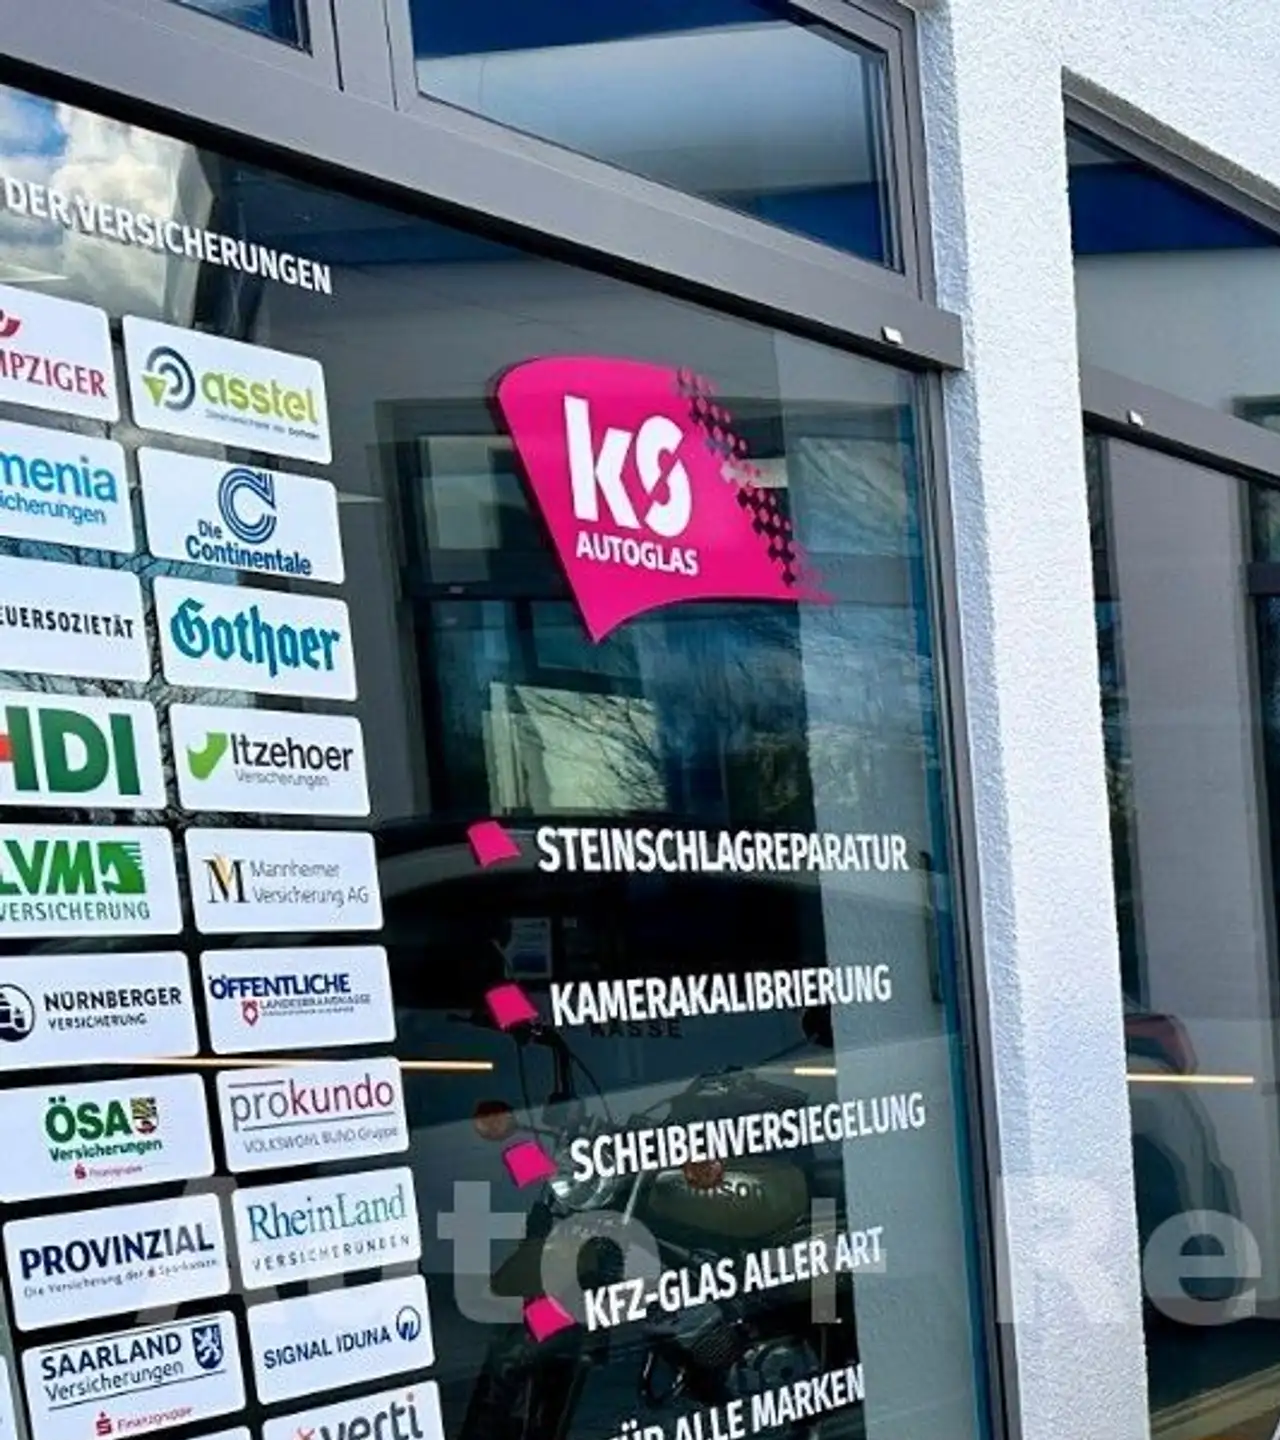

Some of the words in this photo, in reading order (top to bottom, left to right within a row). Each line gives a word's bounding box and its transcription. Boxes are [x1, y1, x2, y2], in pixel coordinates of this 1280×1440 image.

[5, 178, 72, 225] DER
[72, 194, 333, 294] VERSICHERUNGEN
[201, 371, 319, 424] asstel
[197, 519, 222, 539] Die
[185, 534, 312, 575] Continentale
[576, 531, 699, 576] AUTOGLAS
[170, 598, 341, 677] Gothaer
[230, 733, 353, 770] Itzehoer
[537, 826, 909, 872] STEINSCHLAGREPARATUR
[347, 886, 369, 903] AG
[43, 986, 182, 1012] NÜRNBERGER
[208, 973, 351, 1000] ÖFFENTLICHE
[550, 965, 892, 1027] KAMERAKALIBRIERUNG
[49, 1012, 147, 1031] VERSICHERUNG
[45, 1096, 132, 1143] ÖSA
[230, 1073, 395, 1132] prokundo
[49, 1139, 162, 1162] Versicherungen
[570, 1093, 926, 1181] SCHEIBENVERSIEGELUNG
[247, 1183, 407, 1243] RheinLand
[20, 1224, 214, 1280] PROVINZIAL
[583, 1258, 736, 1331] KFZ-GLAS
[743, 1239, 827, 1291] ALLER
[835, 1227, 883, 1271] ART
[41, 1333, 182, 1381] SAARLAND
[263, 1338, 332, 1369] SIGNAL
[336, 1326, 392, 1353] IDUNA
[45, 1361, 184, 1401] Versicherungen
[752, 1363, 865, 1434] MARKEN
